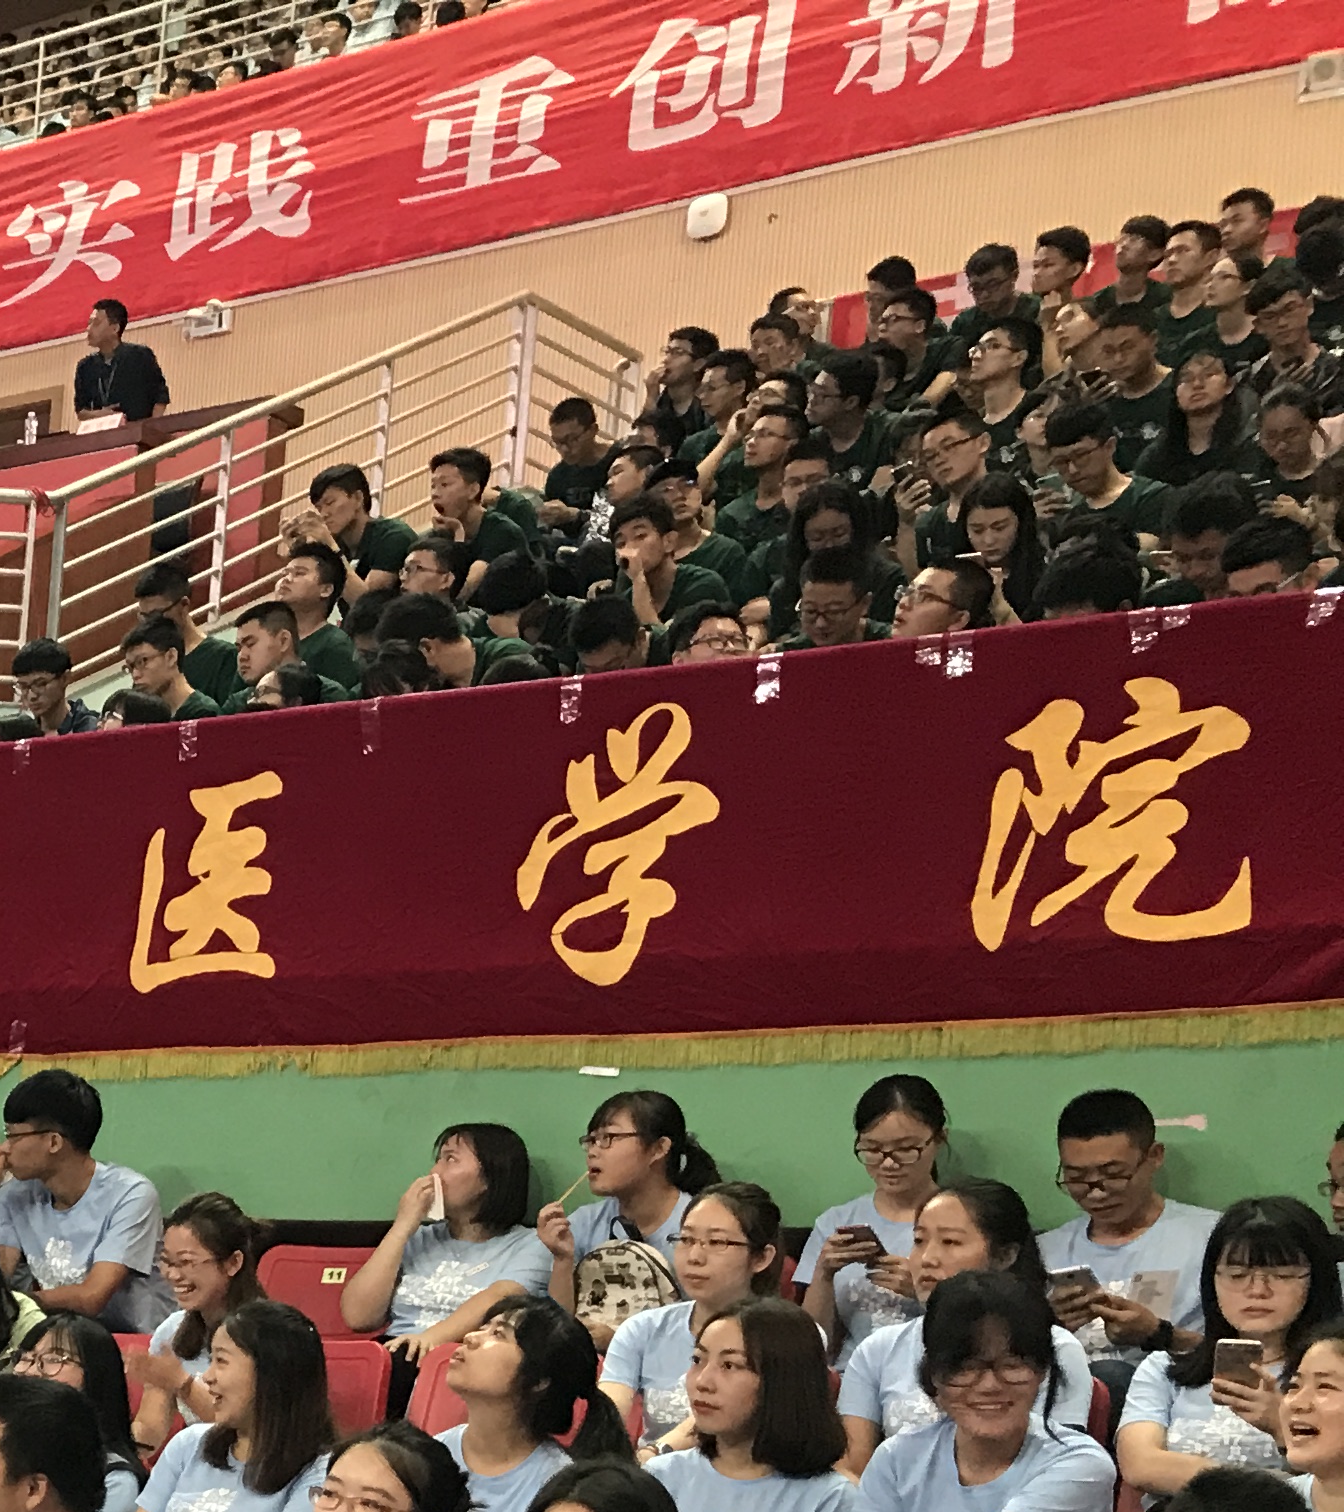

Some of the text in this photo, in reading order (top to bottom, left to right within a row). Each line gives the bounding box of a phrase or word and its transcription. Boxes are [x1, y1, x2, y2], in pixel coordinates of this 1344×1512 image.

[398, 0, 1015, 204] 重创新
[129, 677, 1252, 994] 医学院
[328, 1270, 342, 1280] 11
